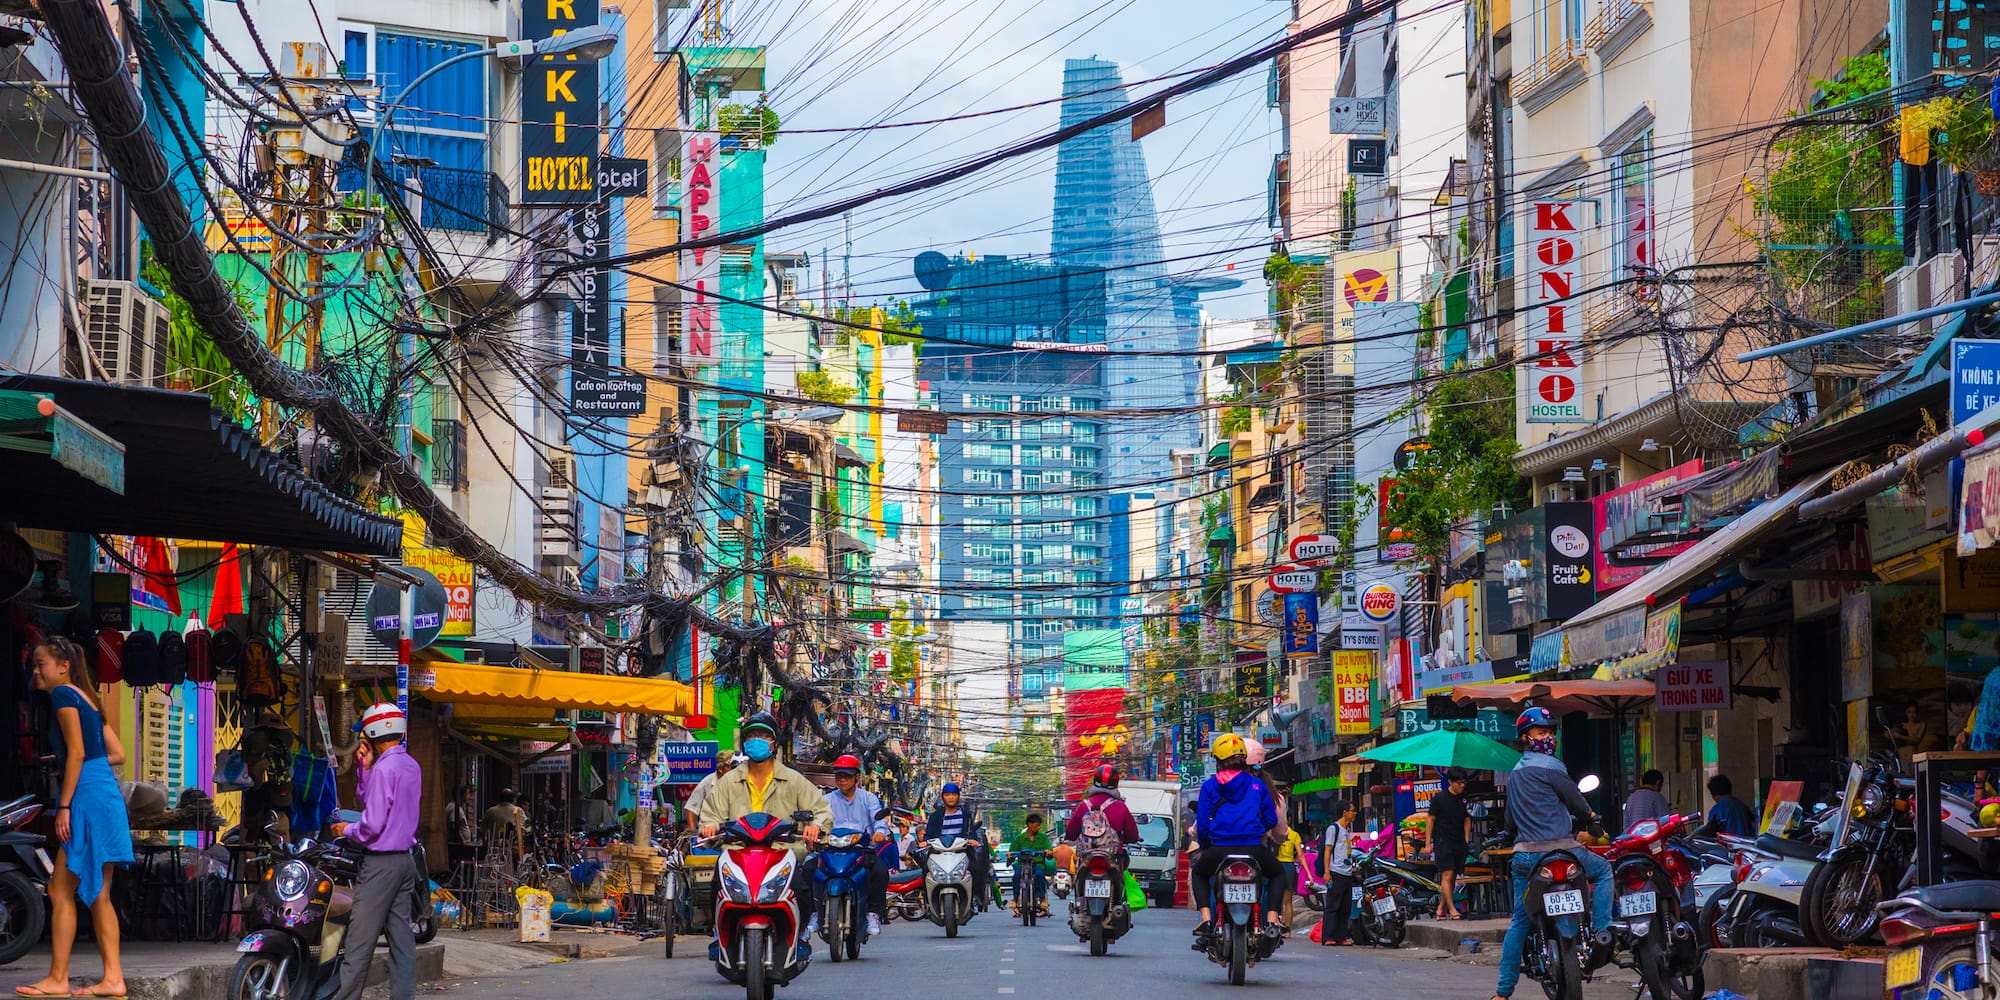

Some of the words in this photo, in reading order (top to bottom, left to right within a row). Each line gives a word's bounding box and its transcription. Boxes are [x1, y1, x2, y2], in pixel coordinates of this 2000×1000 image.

[527, 156, 593, 191] HOTEL
[690, 137, 711, 265] HAPPY
[1533, 203, 1578, 403] KONIKO
[690, 281, 712, 355] INN
[1961, 366, 1994, 385] KHÔNG
[575, 380, 595, 391] Cafe
[596, 382, 606, 391] on
[607, 380, 642, 394] Rooftop
[600, 392, 617, 400] and
[1966, 389, 1979, 410] ĐỂ
[575, 400, 641, 410] Restaurant
[1532, 405, 1581, 417] HOSTEL
[1300, 545, 1336, 554] HOTEL
[1552, 564, 1579, 574] Fruit
[437, 569, 471, 584] SÁU
[1277, 574, 1313, 582] HOTEL
[1553, 574, 1578, 584] Cafe
[1365, 591, 1396, 601] BURGER
[1364, 600, 1395, 610] KING
[1292, 605, 1314, 649] Tiger
[1344, 635, 1356, 645] TY'S
[1357, 635, 1377, 645] STORE
[1241, 665, 1262, 675] Gym
[1248, 676, 1256, 684] &
[1336, 670, 1352, 685] BÀ
[1696, 668, 1713, 685] XE
[1242, 685, 1261, 695] Spa
[1343, 687, 1370, 704] BB
[1661, 690, 1697, 706] TRONG
[1340, 705, 1361, 722] Saigon
[1339, 724, 1352, 732] 135
[667, 745, 708, 754] MERAKI
[693, 758, 712, 769] Hotel
[1414, 783, 1442, 792] DOUBLE
[1228, 893, 1252, 901] 7492
